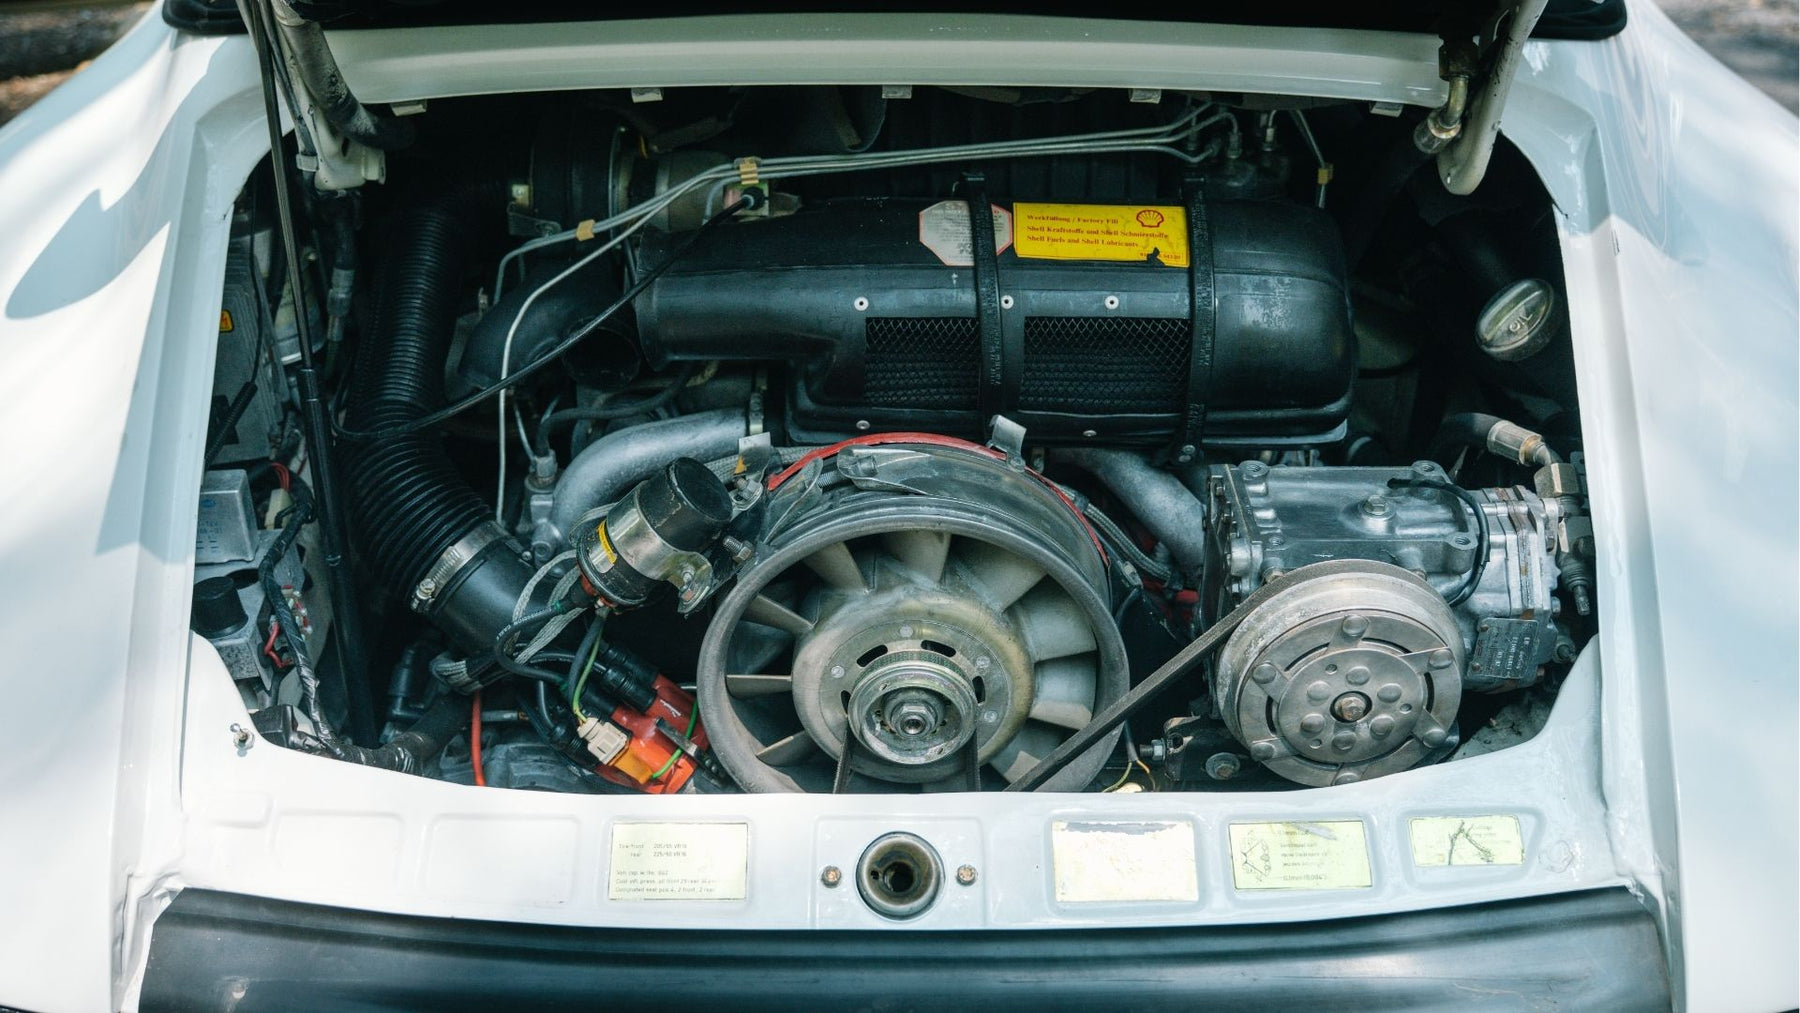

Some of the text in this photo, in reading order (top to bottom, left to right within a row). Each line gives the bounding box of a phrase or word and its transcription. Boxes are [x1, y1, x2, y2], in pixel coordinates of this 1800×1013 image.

[1047, 226, 1084, 234] Kraftstoffe
[1120, 231, 1168, 239] Schmierstoffe
[1101, 239, 1139, 248] Lubricants
[1509, 313, 1533, 332] OIL
